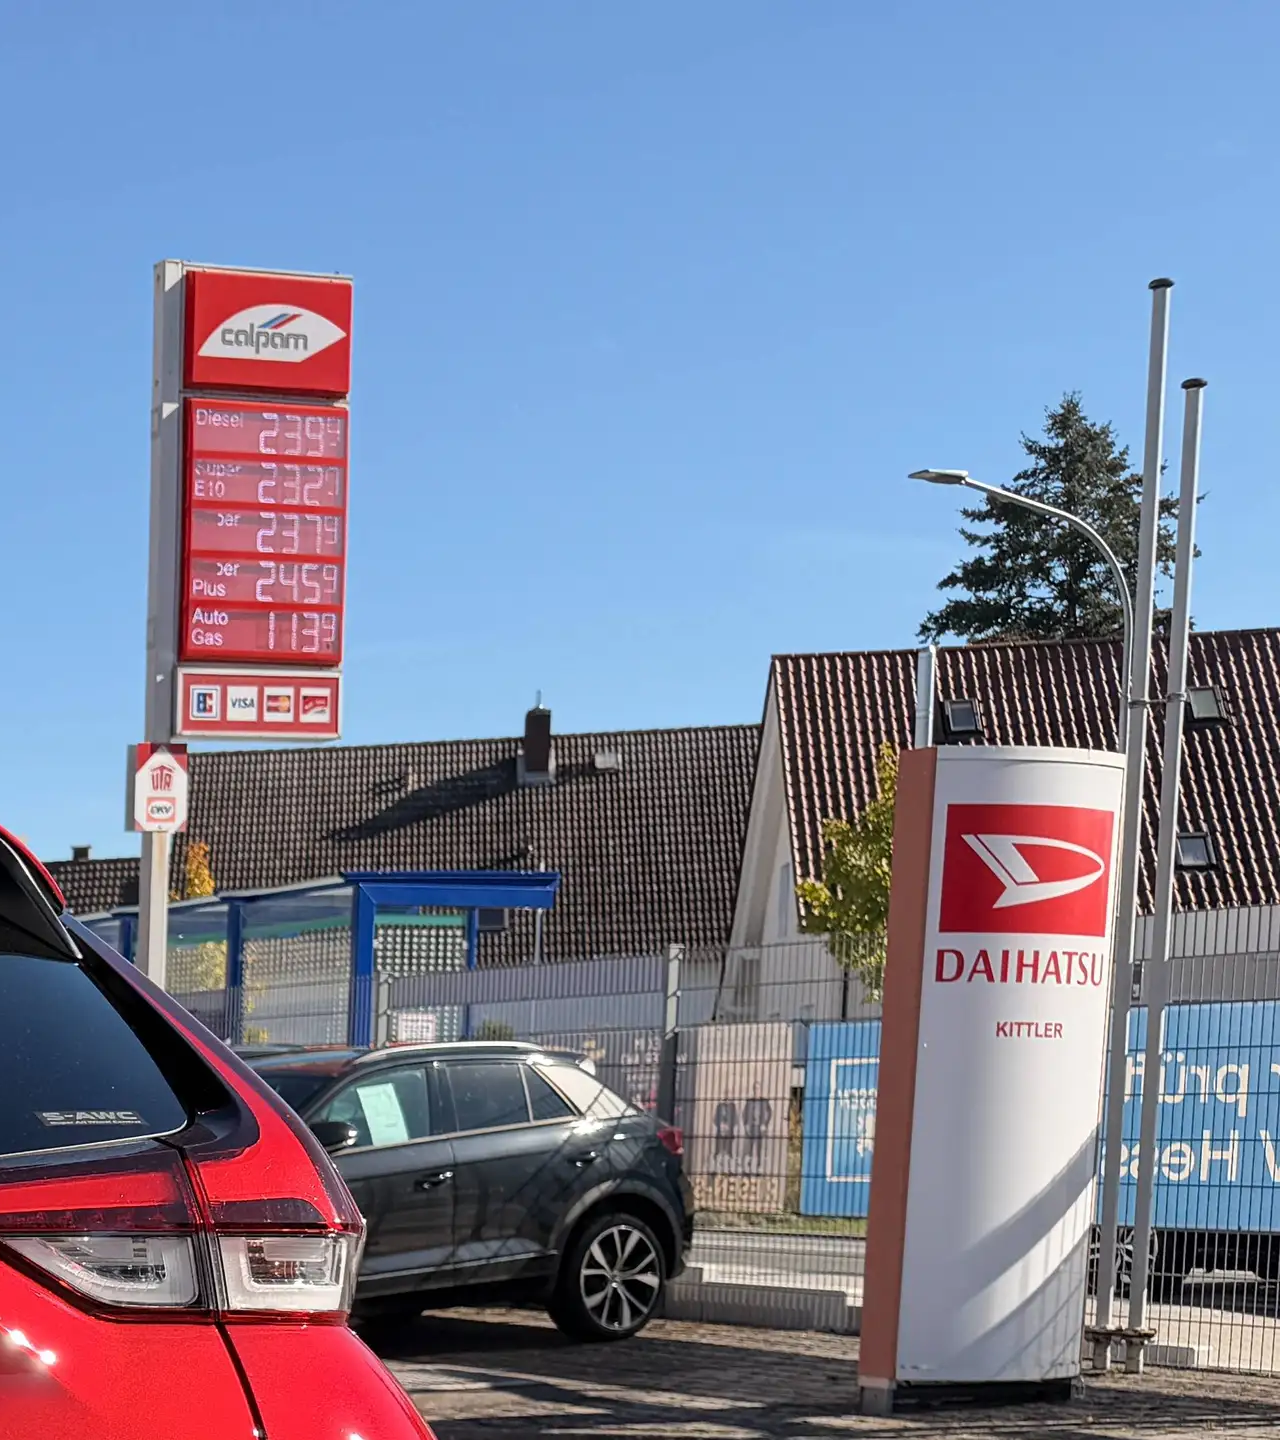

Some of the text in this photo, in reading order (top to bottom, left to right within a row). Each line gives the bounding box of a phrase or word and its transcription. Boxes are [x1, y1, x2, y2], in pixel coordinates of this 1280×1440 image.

[220, 322, 308, 355] calpam
[195, 408, 244, 428] Diesel
[194, 479, 226, 498] E10
[192, 578, 227, 597] Plus
[192, 607, 229, 626] Auto
[191, 628, 224, 646] Gas
[231, 697, 255, 709] VISA
[934, 948, 1104, 987] DAIHATSU
[995, 1021, 1064, 1039] KITTLER
[42, 1111, 139, 1121] S-AWC
